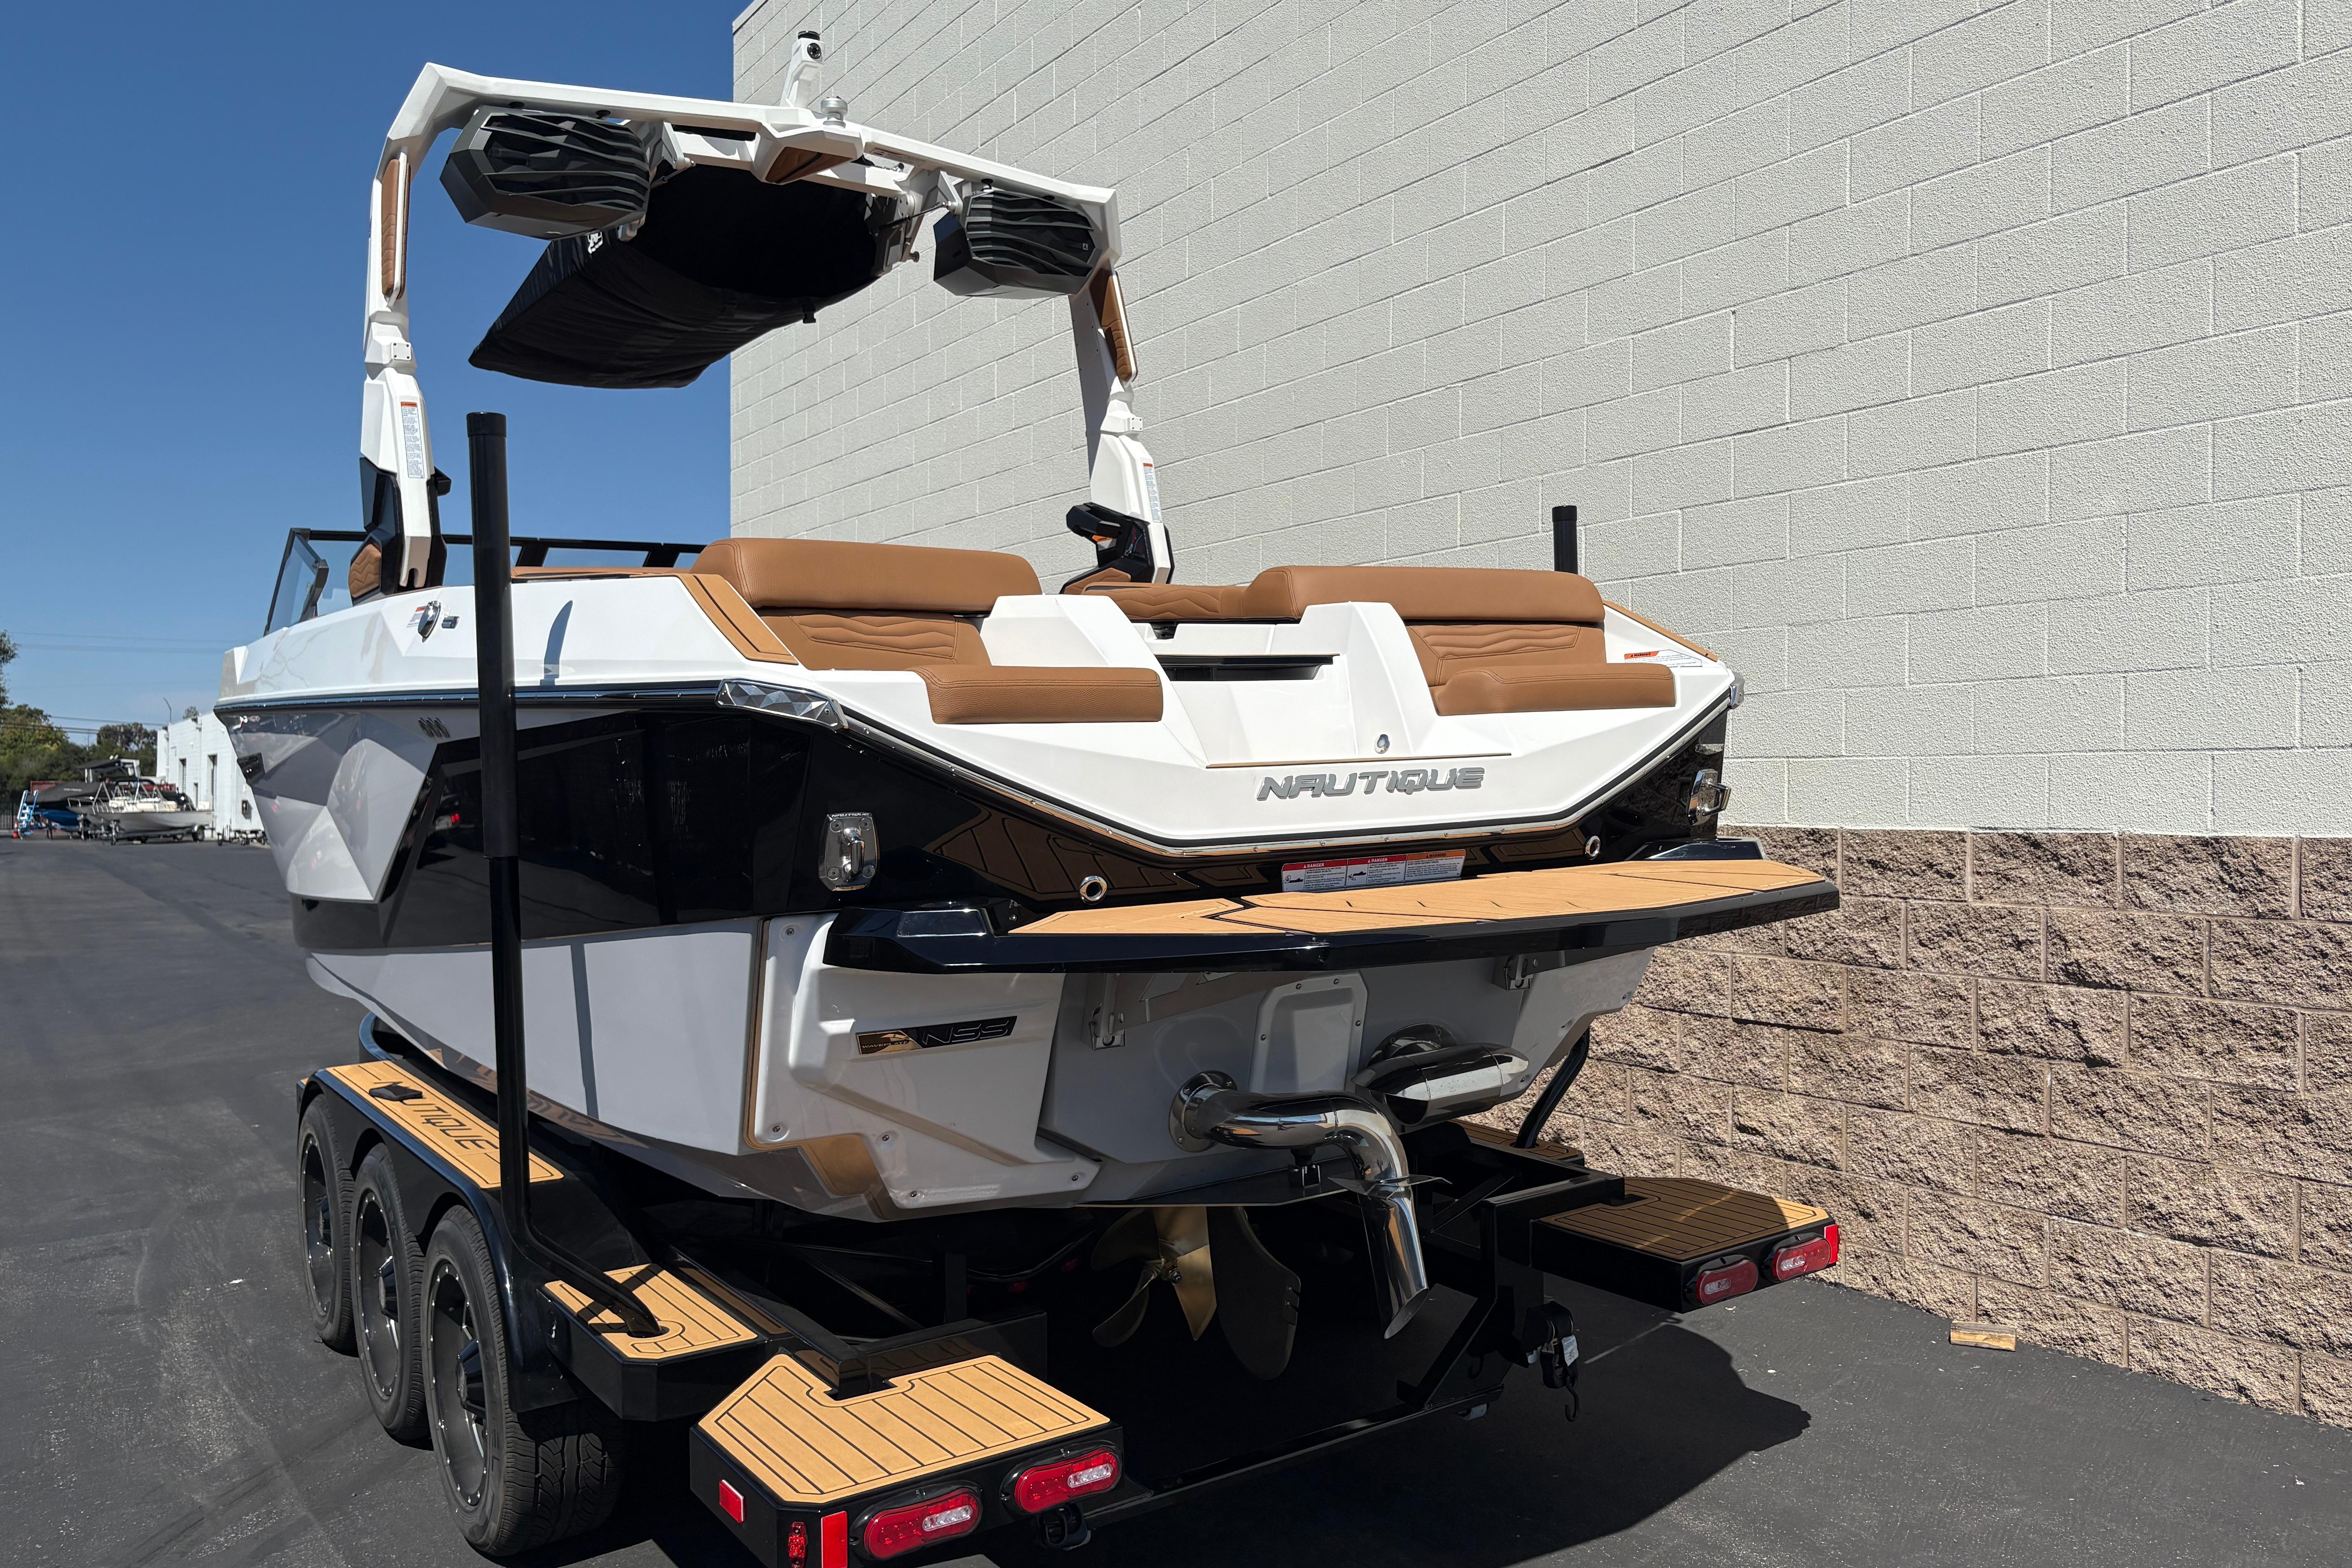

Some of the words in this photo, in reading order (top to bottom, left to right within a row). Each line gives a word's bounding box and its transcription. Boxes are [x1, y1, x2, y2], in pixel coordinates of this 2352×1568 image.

[1257, 767, 1484, 801] NAUTIQUE
[922, 1020, 1009, 1045] NSS
[373, 1081, 499, 1150] UTIQUE
